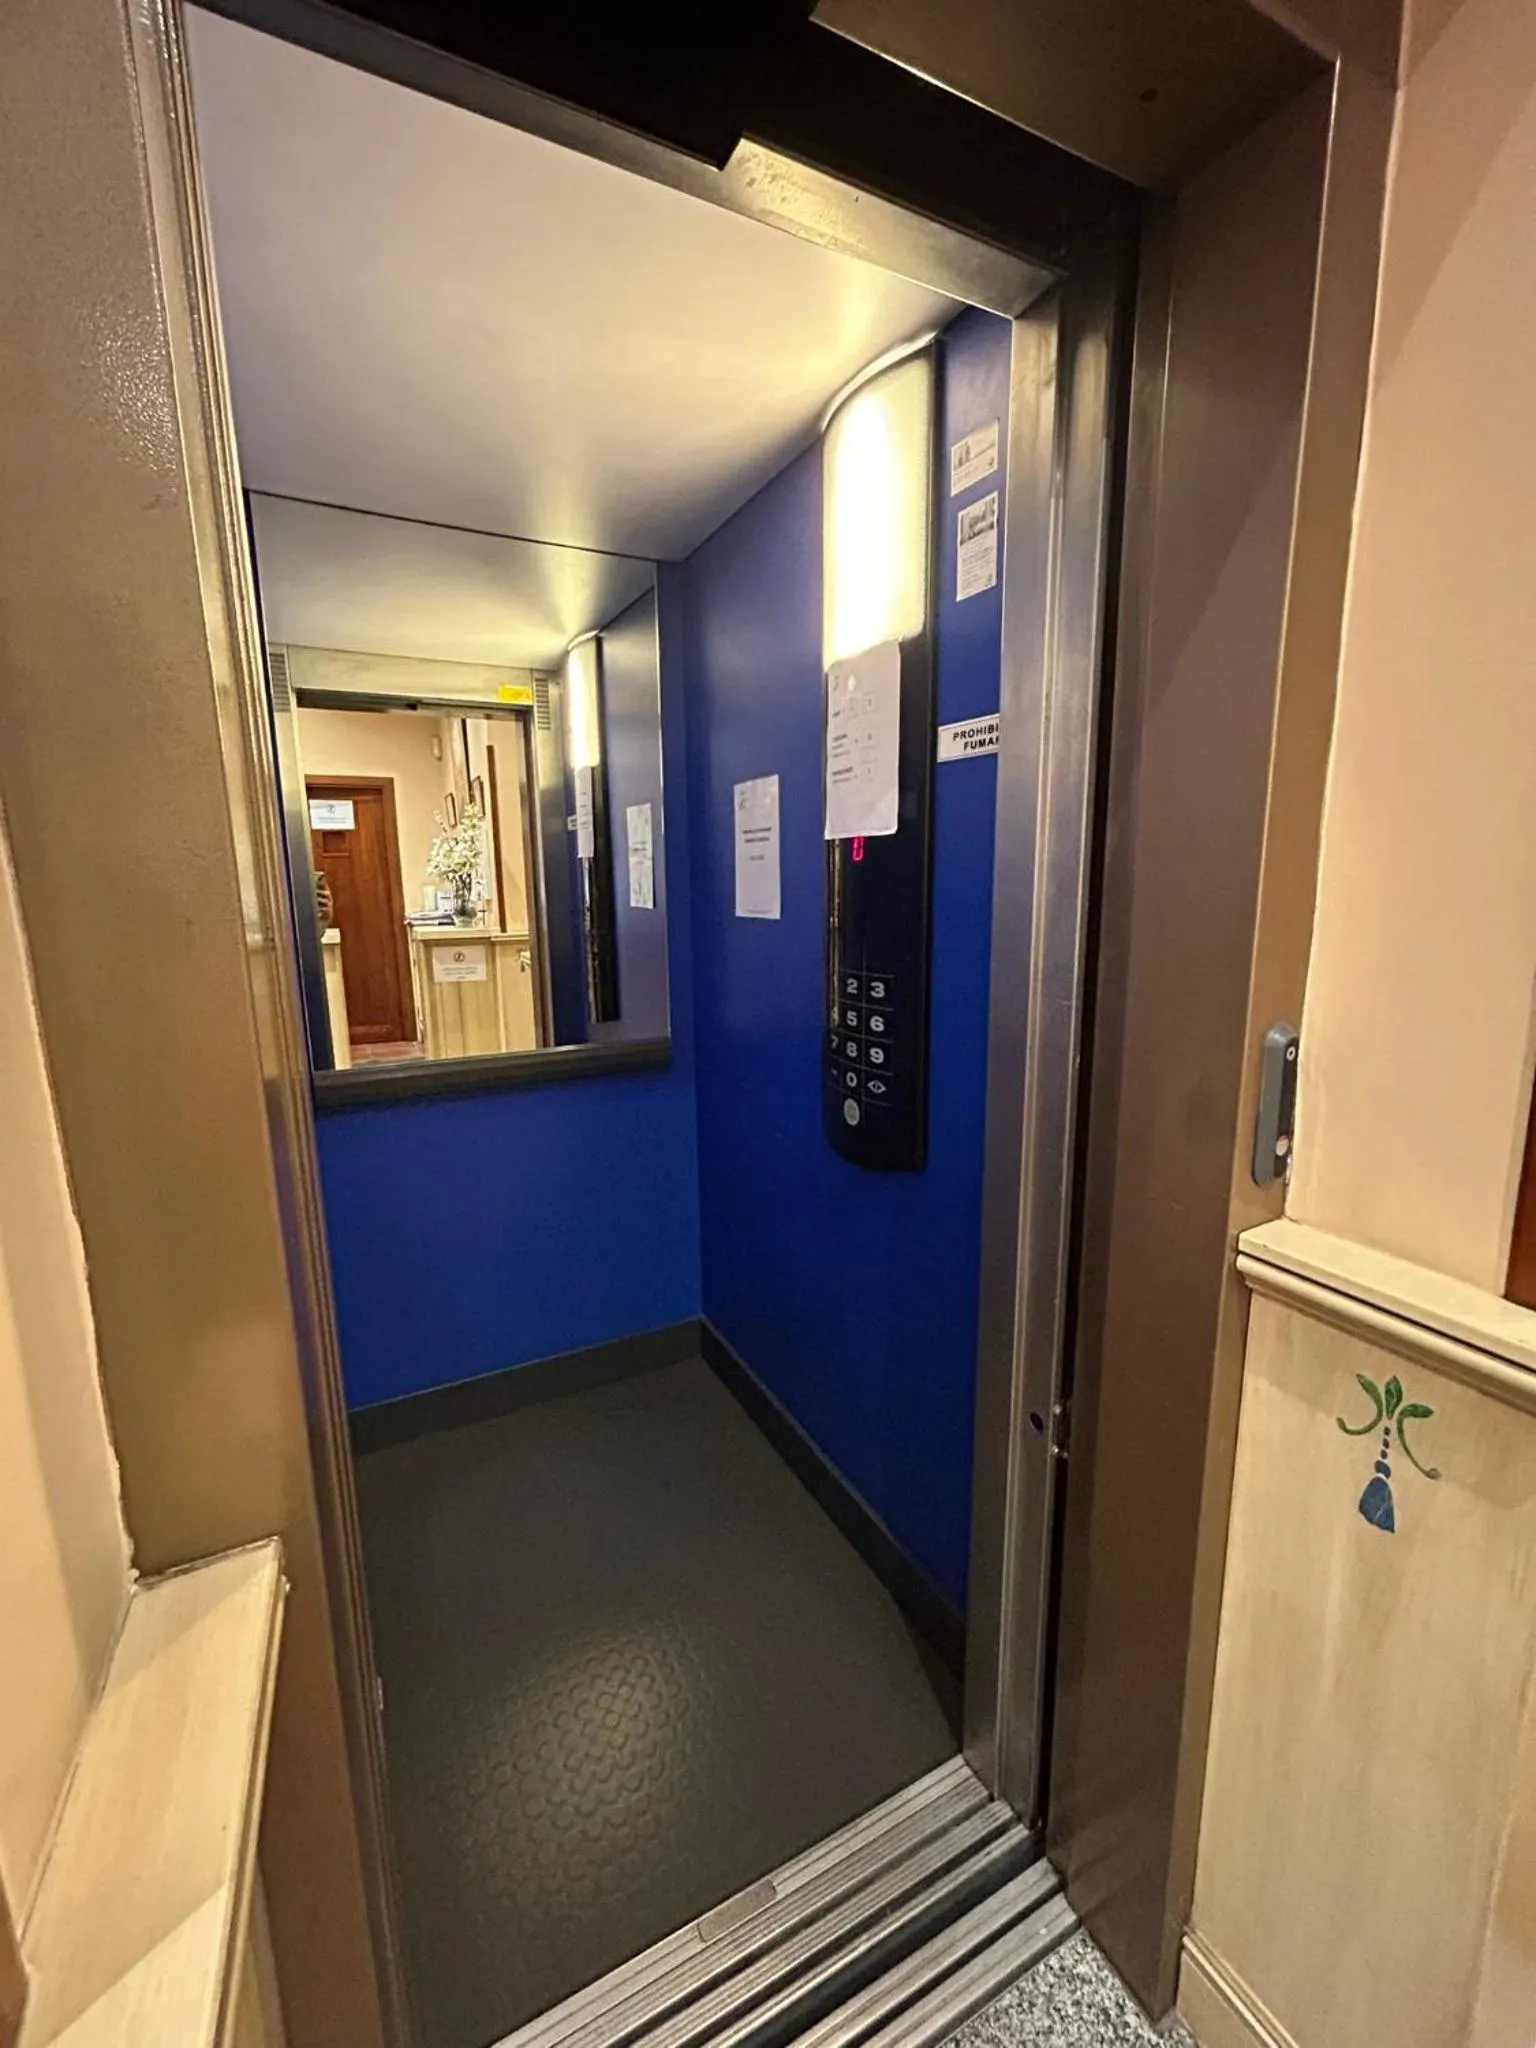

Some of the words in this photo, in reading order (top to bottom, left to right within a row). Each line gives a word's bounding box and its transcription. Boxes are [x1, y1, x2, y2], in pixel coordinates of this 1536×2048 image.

[846, 978, 858, 994] 2
[870, 981, 886, 998] 3
[846, 1011, 858, 1027] 5
[869, 1015, 885, 1032] 6
[830, 1035, 839, 1049] 7
[846, 1041, 858, 1058] 8
[869, 1047, 885, 1064] 9
[846, 1071, 858, 1087] 0
